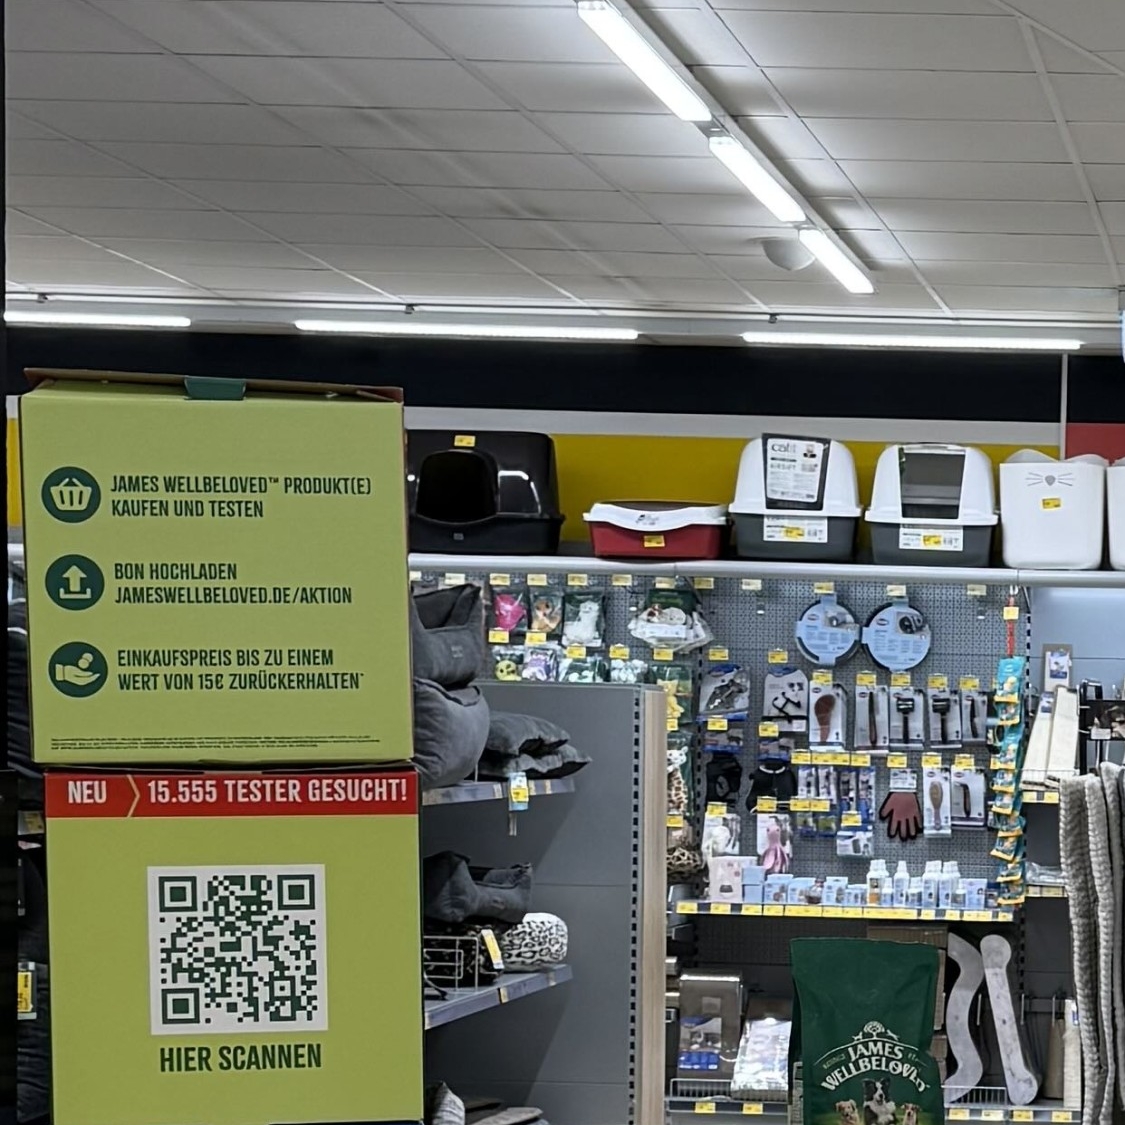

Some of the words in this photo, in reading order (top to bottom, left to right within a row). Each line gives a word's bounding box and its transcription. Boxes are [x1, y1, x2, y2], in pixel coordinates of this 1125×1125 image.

[111, 475, 159, 493] JAMES
[284, 477, 372, 495] PRODUKT(E)
[111, 500, 169, 517] KAUFEN
[174, 500, 204, 517] UND
[210, 500, 264, 518] TESTEN
[114, 563, 145, 580] BON
[150, 563, 237, 580] HOCHLADEN
[115, 586, 352, 604] JAMESWELLBELOVED.DE/AKTION
[118, 649, 232, 667] EINKAUFSPREIS
[236, 649, 260, 667] BIS
[264, 649, 283, 667] ZU
[288, 649, 333, 667] EINEM
[118, 673, 159, 691] WERT
[164, 673, 194, 691] VON
[198, 673, 224, 690] 15€
[68, 780, 107, 804] NEU
[147, 780, 217, 803] 15.555
[224, 779, 301, 803] TESTER
[308, 778, 408, 802] GESUCHT!
[160, 1046, 213, 1072] HIER
[218, 1043, 322, 1070] SCANNEN
[848, 1041, 904, 1061] JAMES
